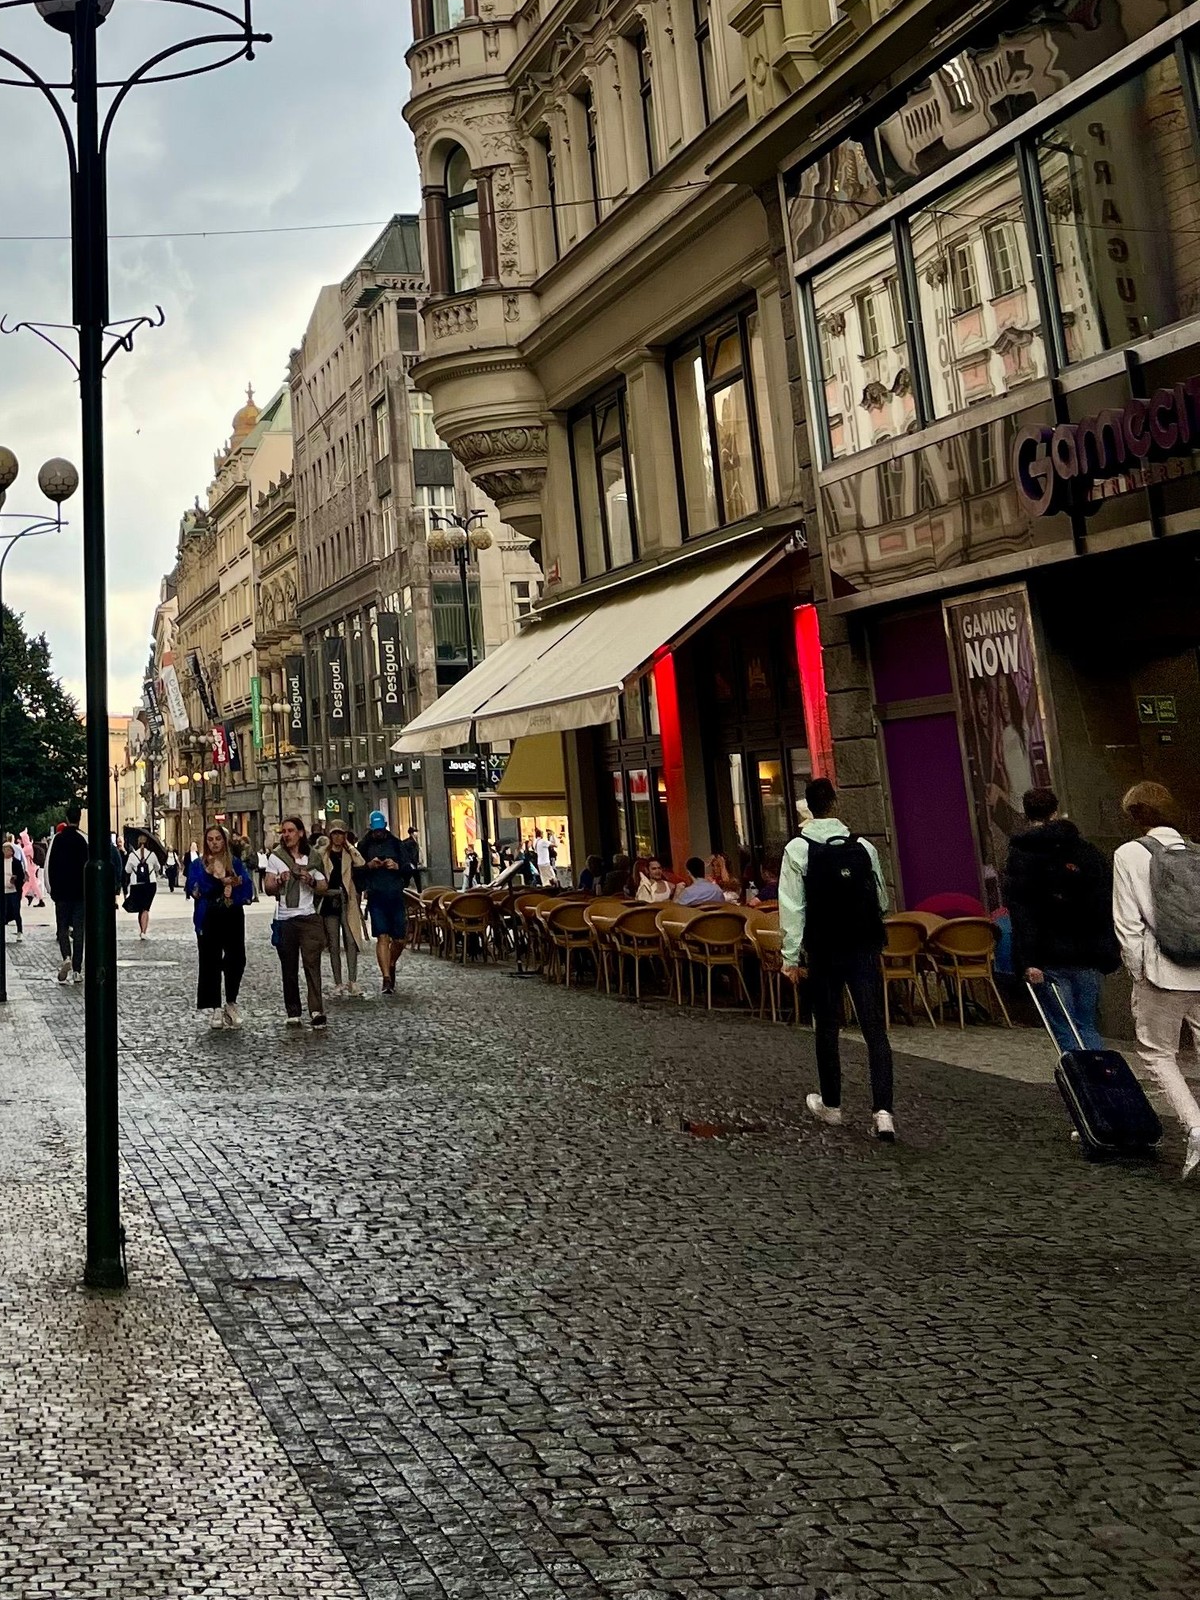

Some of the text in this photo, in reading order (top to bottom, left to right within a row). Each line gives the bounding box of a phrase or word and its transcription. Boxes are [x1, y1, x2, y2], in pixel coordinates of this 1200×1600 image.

[962, 606, 1017, 639] GAMING
[381, 636, 399, 704] Desigual.
[964, 633, 1019, 679] NOW
[289, 674, 303, 728] Desigual.
[328, 658, 344, 718] Desigual.
